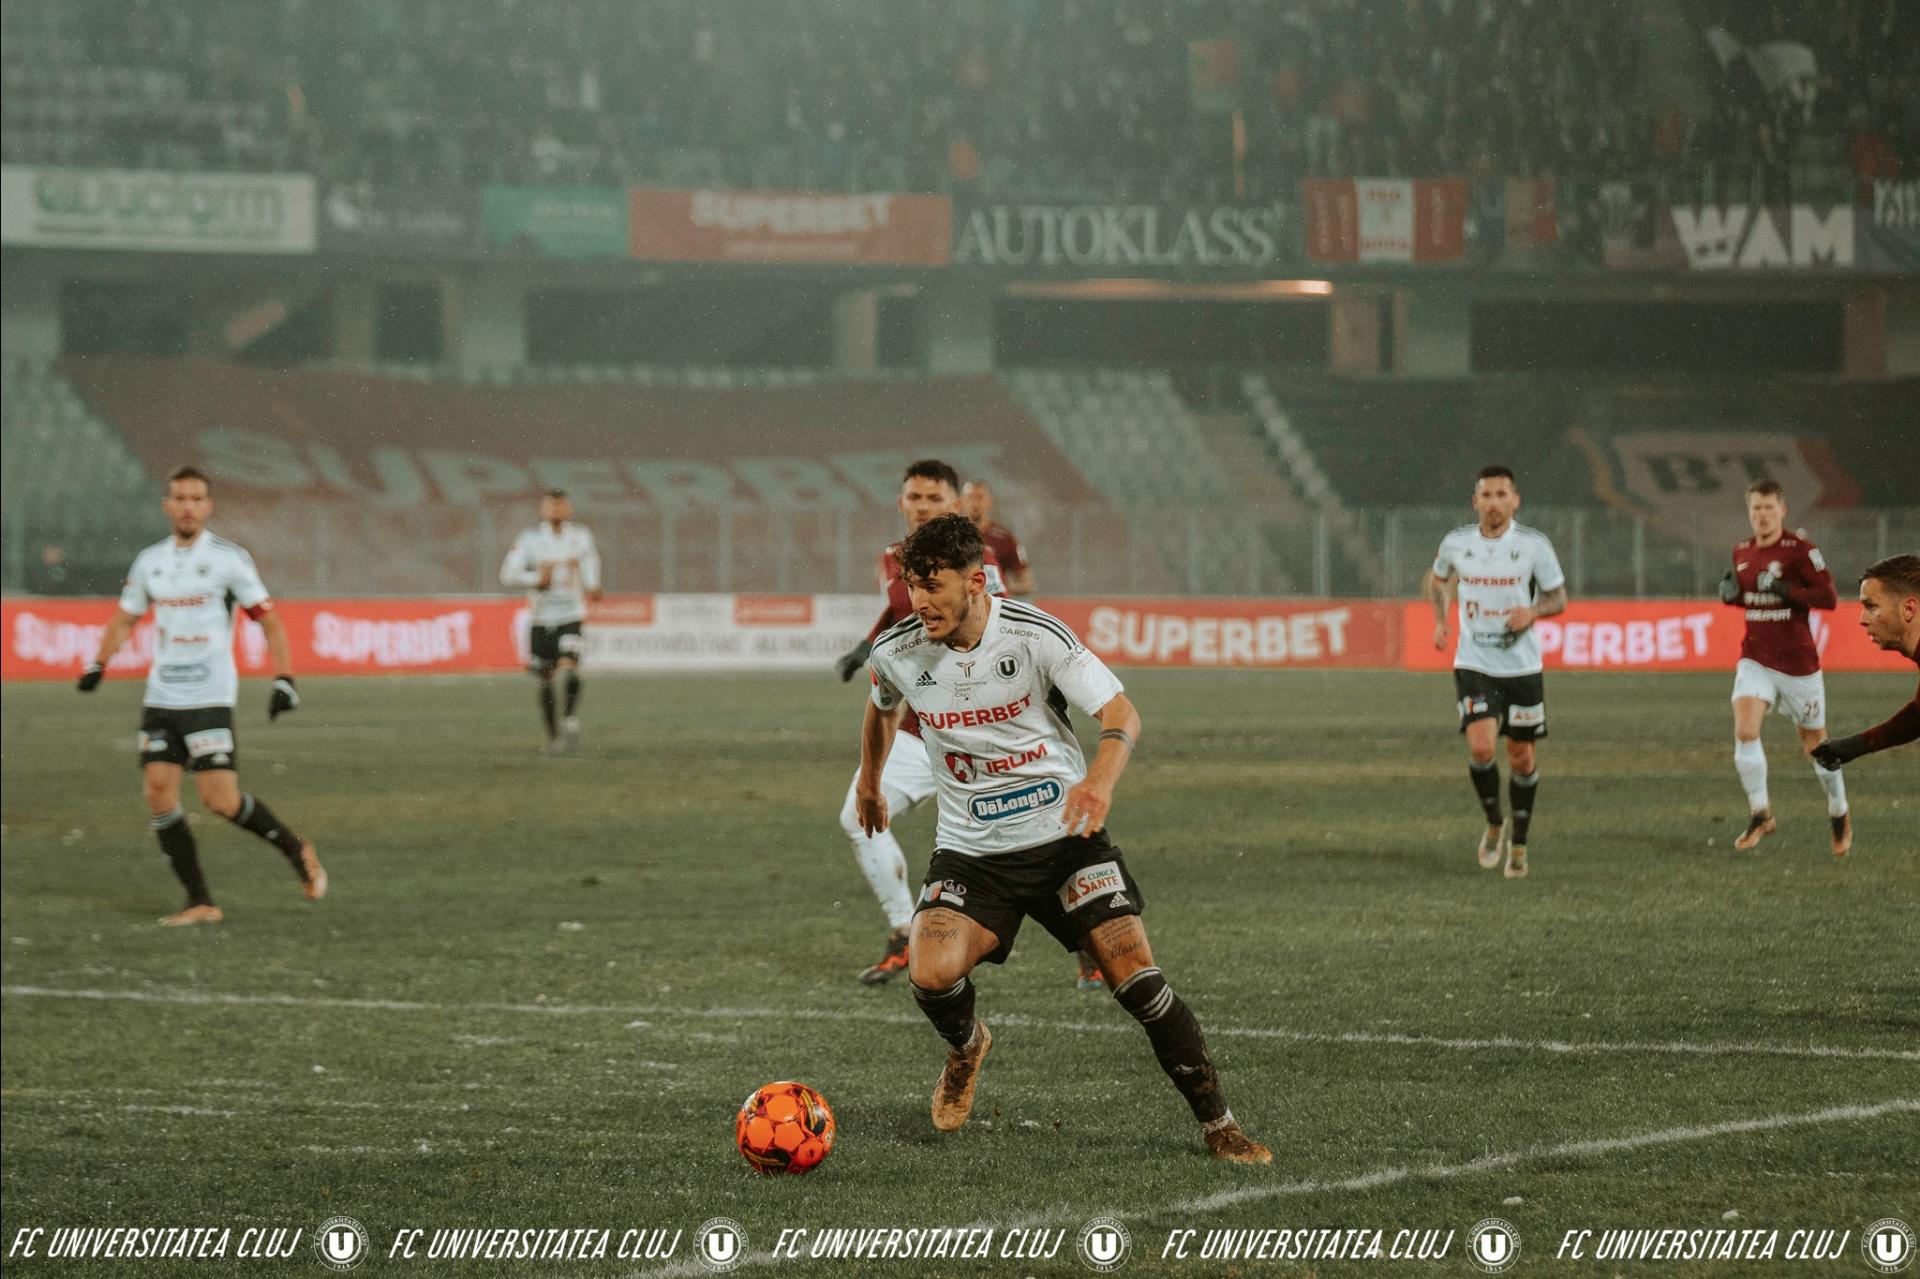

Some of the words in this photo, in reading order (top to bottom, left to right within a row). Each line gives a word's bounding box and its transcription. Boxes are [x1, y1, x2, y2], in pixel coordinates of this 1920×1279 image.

[955, 204, 1276, 267] AUTOKLASS
[1670, 204, 1855, 270] WAM
[1088, 606, 1351, 666] SUPERBET
[1000, 660, 1016, 677] U
[918, 693, 1032, 730] SUPERBET
[985, 742, 1049, 774] IRUM
[1077, 876, 1119, 897] SANTE
[1087, 868, 1116, 881] CLINICA
